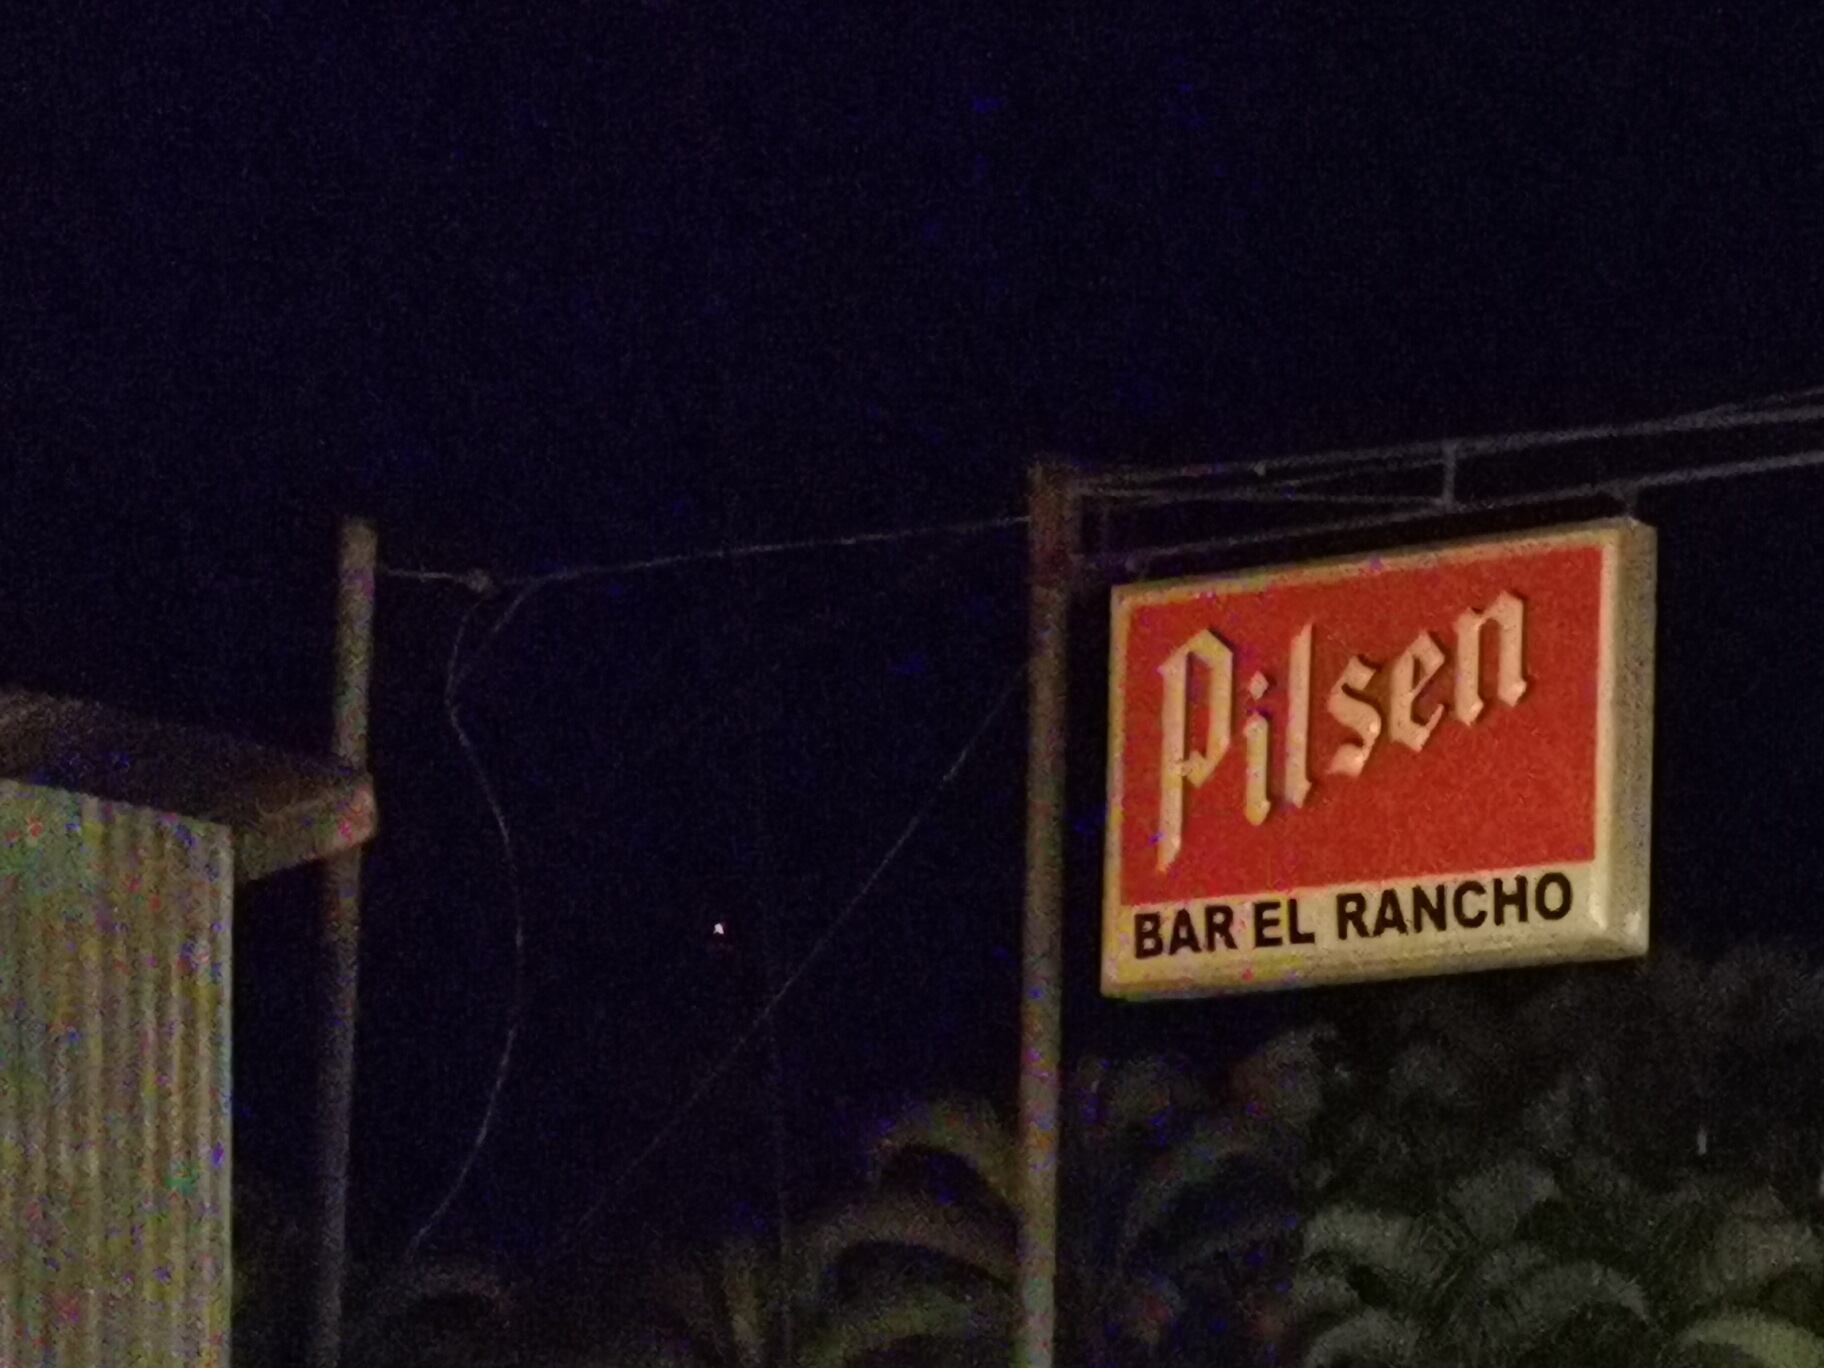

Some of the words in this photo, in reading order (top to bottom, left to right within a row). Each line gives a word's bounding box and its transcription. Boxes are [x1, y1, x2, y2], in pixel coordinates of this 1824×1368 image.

[1157, 590, 1528, 873] Pilsen
[1133, 903, 1238, 959] BAR
[1253, 898, 1316, 947] EL
[1336, 871, 1574, 940] RANCHO
